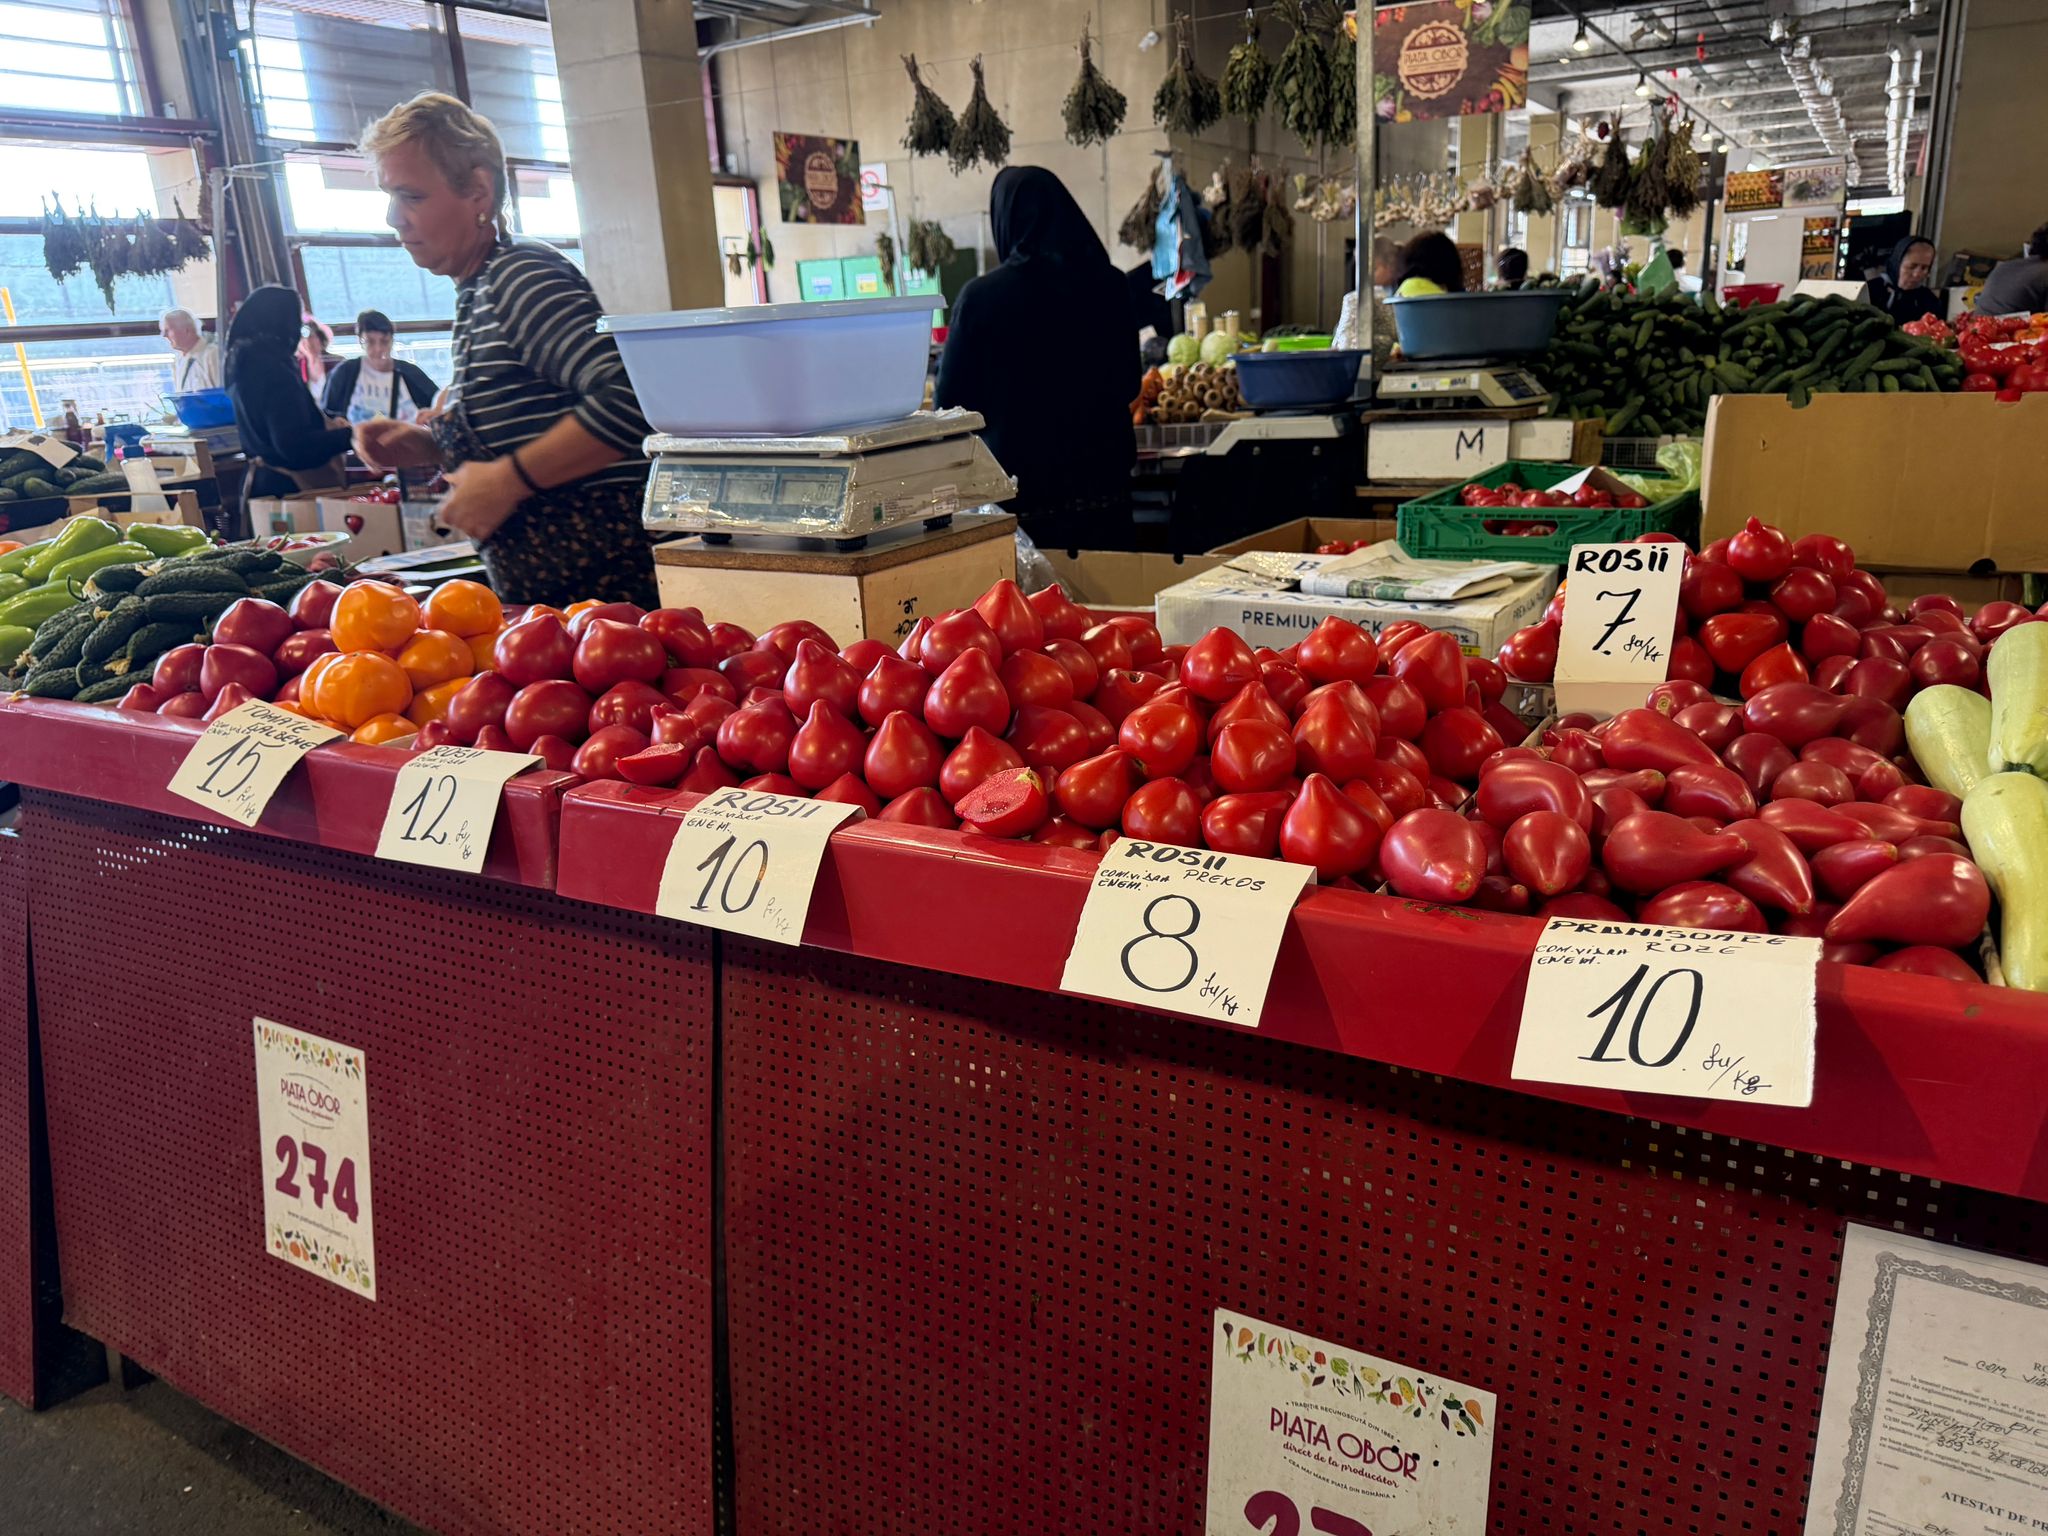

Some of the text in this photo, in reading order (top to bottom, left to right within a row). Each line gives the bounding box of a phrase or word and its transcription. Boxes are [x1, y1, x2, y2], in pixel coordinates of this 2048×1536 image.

[1788, 167, 1843, 179] MIERE
[1729, 188, 1763, 201] MIERE
[243, 704, 321, 734] TOMATE
[197, 735, 285, 798] 15
[713, 791, 822, 819] ROSII
[1125, 842, 1227, 870] ROSII
[690, 835, 769, 913] 10
[1183, 869, 1266, 891] PREKOS
[1121, 894, 1201, 993] 8
[1646, 941, 1744, 955] ROZE
[275, 1135, 359, 1223] 274
[1270, 1407, 1419, 1482] PIATA OBOR
[1283, 1441, 1312, 1458] direct
[1314, 1450, 1327, 1463] de
[1328, 1456, 1339, 1468] la
[1941, 1491, 2005, 1517] ATESTAT
[2008, 1511, 2028, 1525] DE
